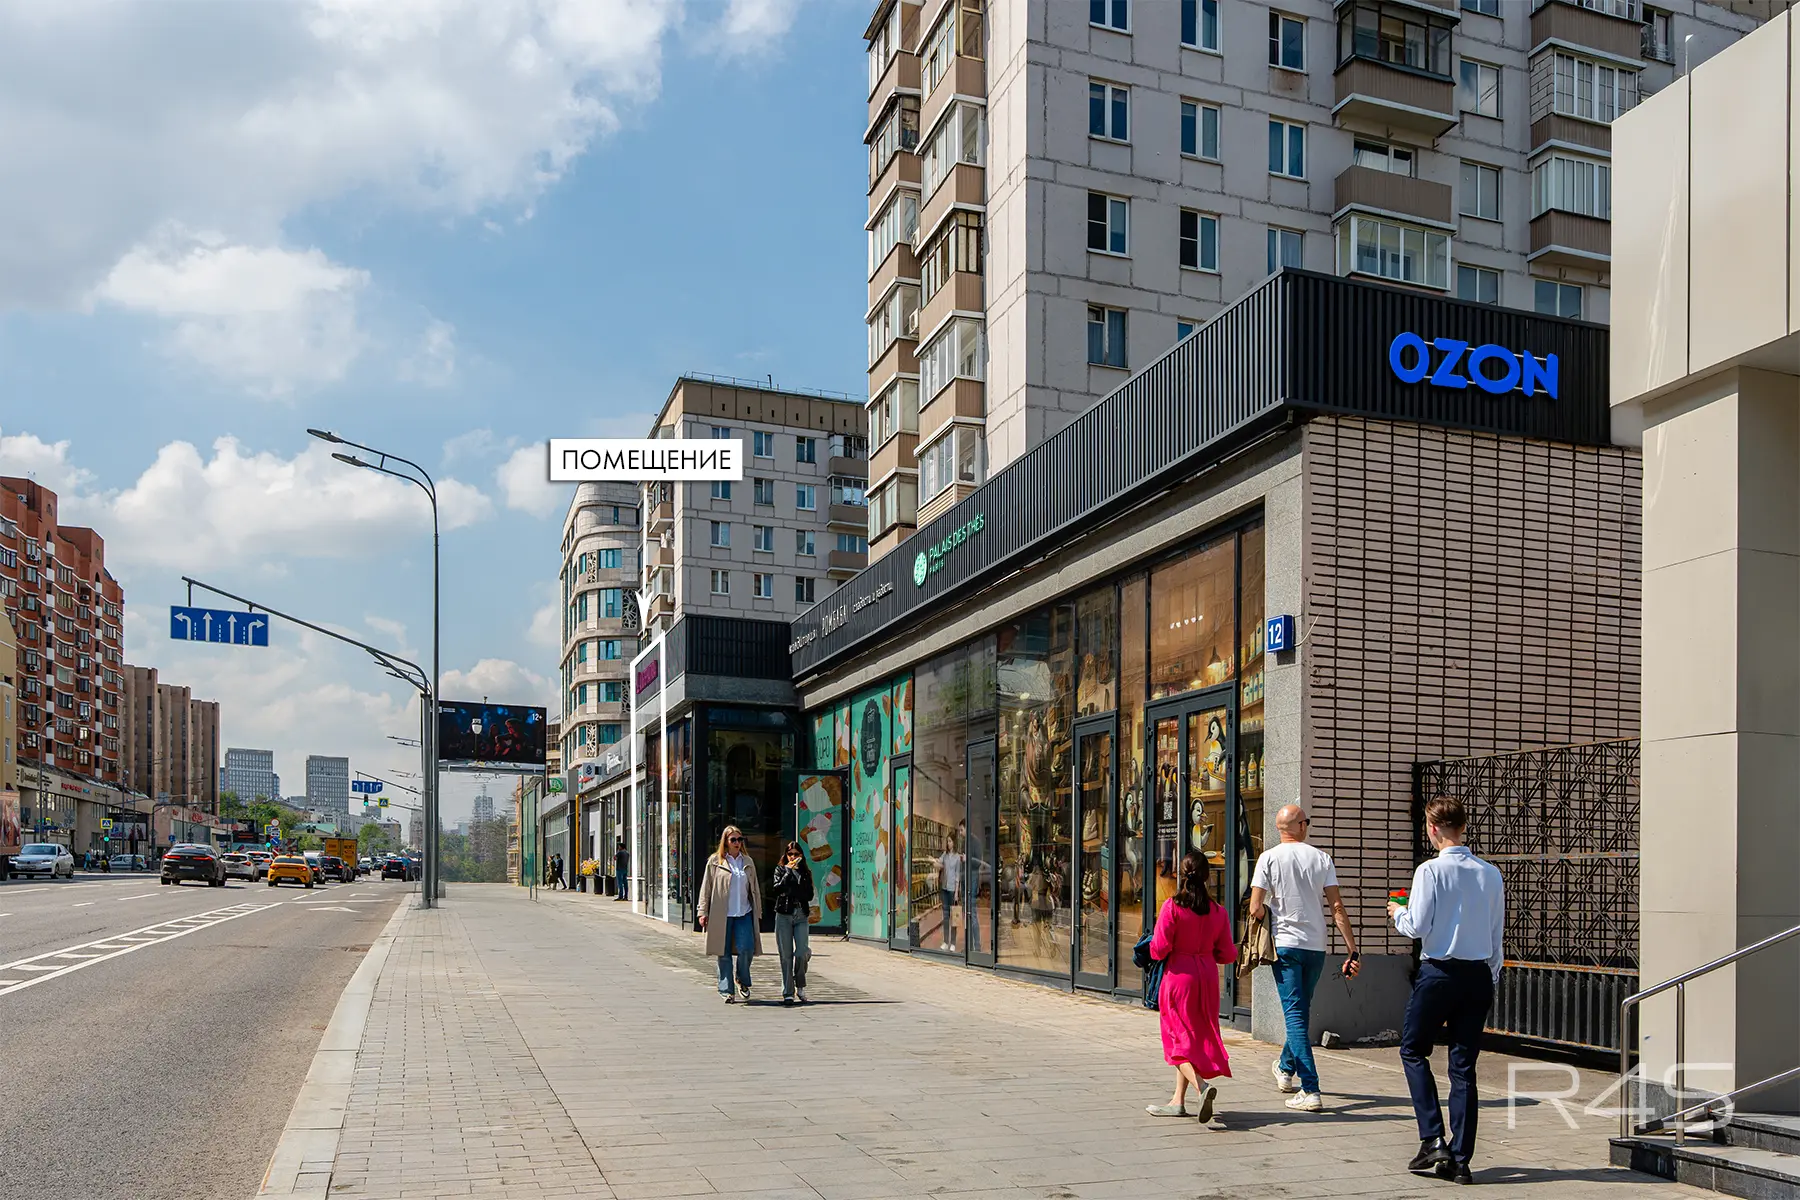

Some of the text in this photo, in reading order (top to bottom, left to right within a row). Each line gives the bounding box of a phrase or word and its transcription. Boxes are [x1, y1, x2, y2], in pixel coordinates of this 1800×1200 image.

[1389, 331, 1558, 400] OZON
[929, 535, 953, 560] PALAIS
[953, 526, 967, 547] DES
[929, 559, 944, 574] PARIS
[1269, 623, 1282, 645] 12
[531, 713, 543, 721] 12+
